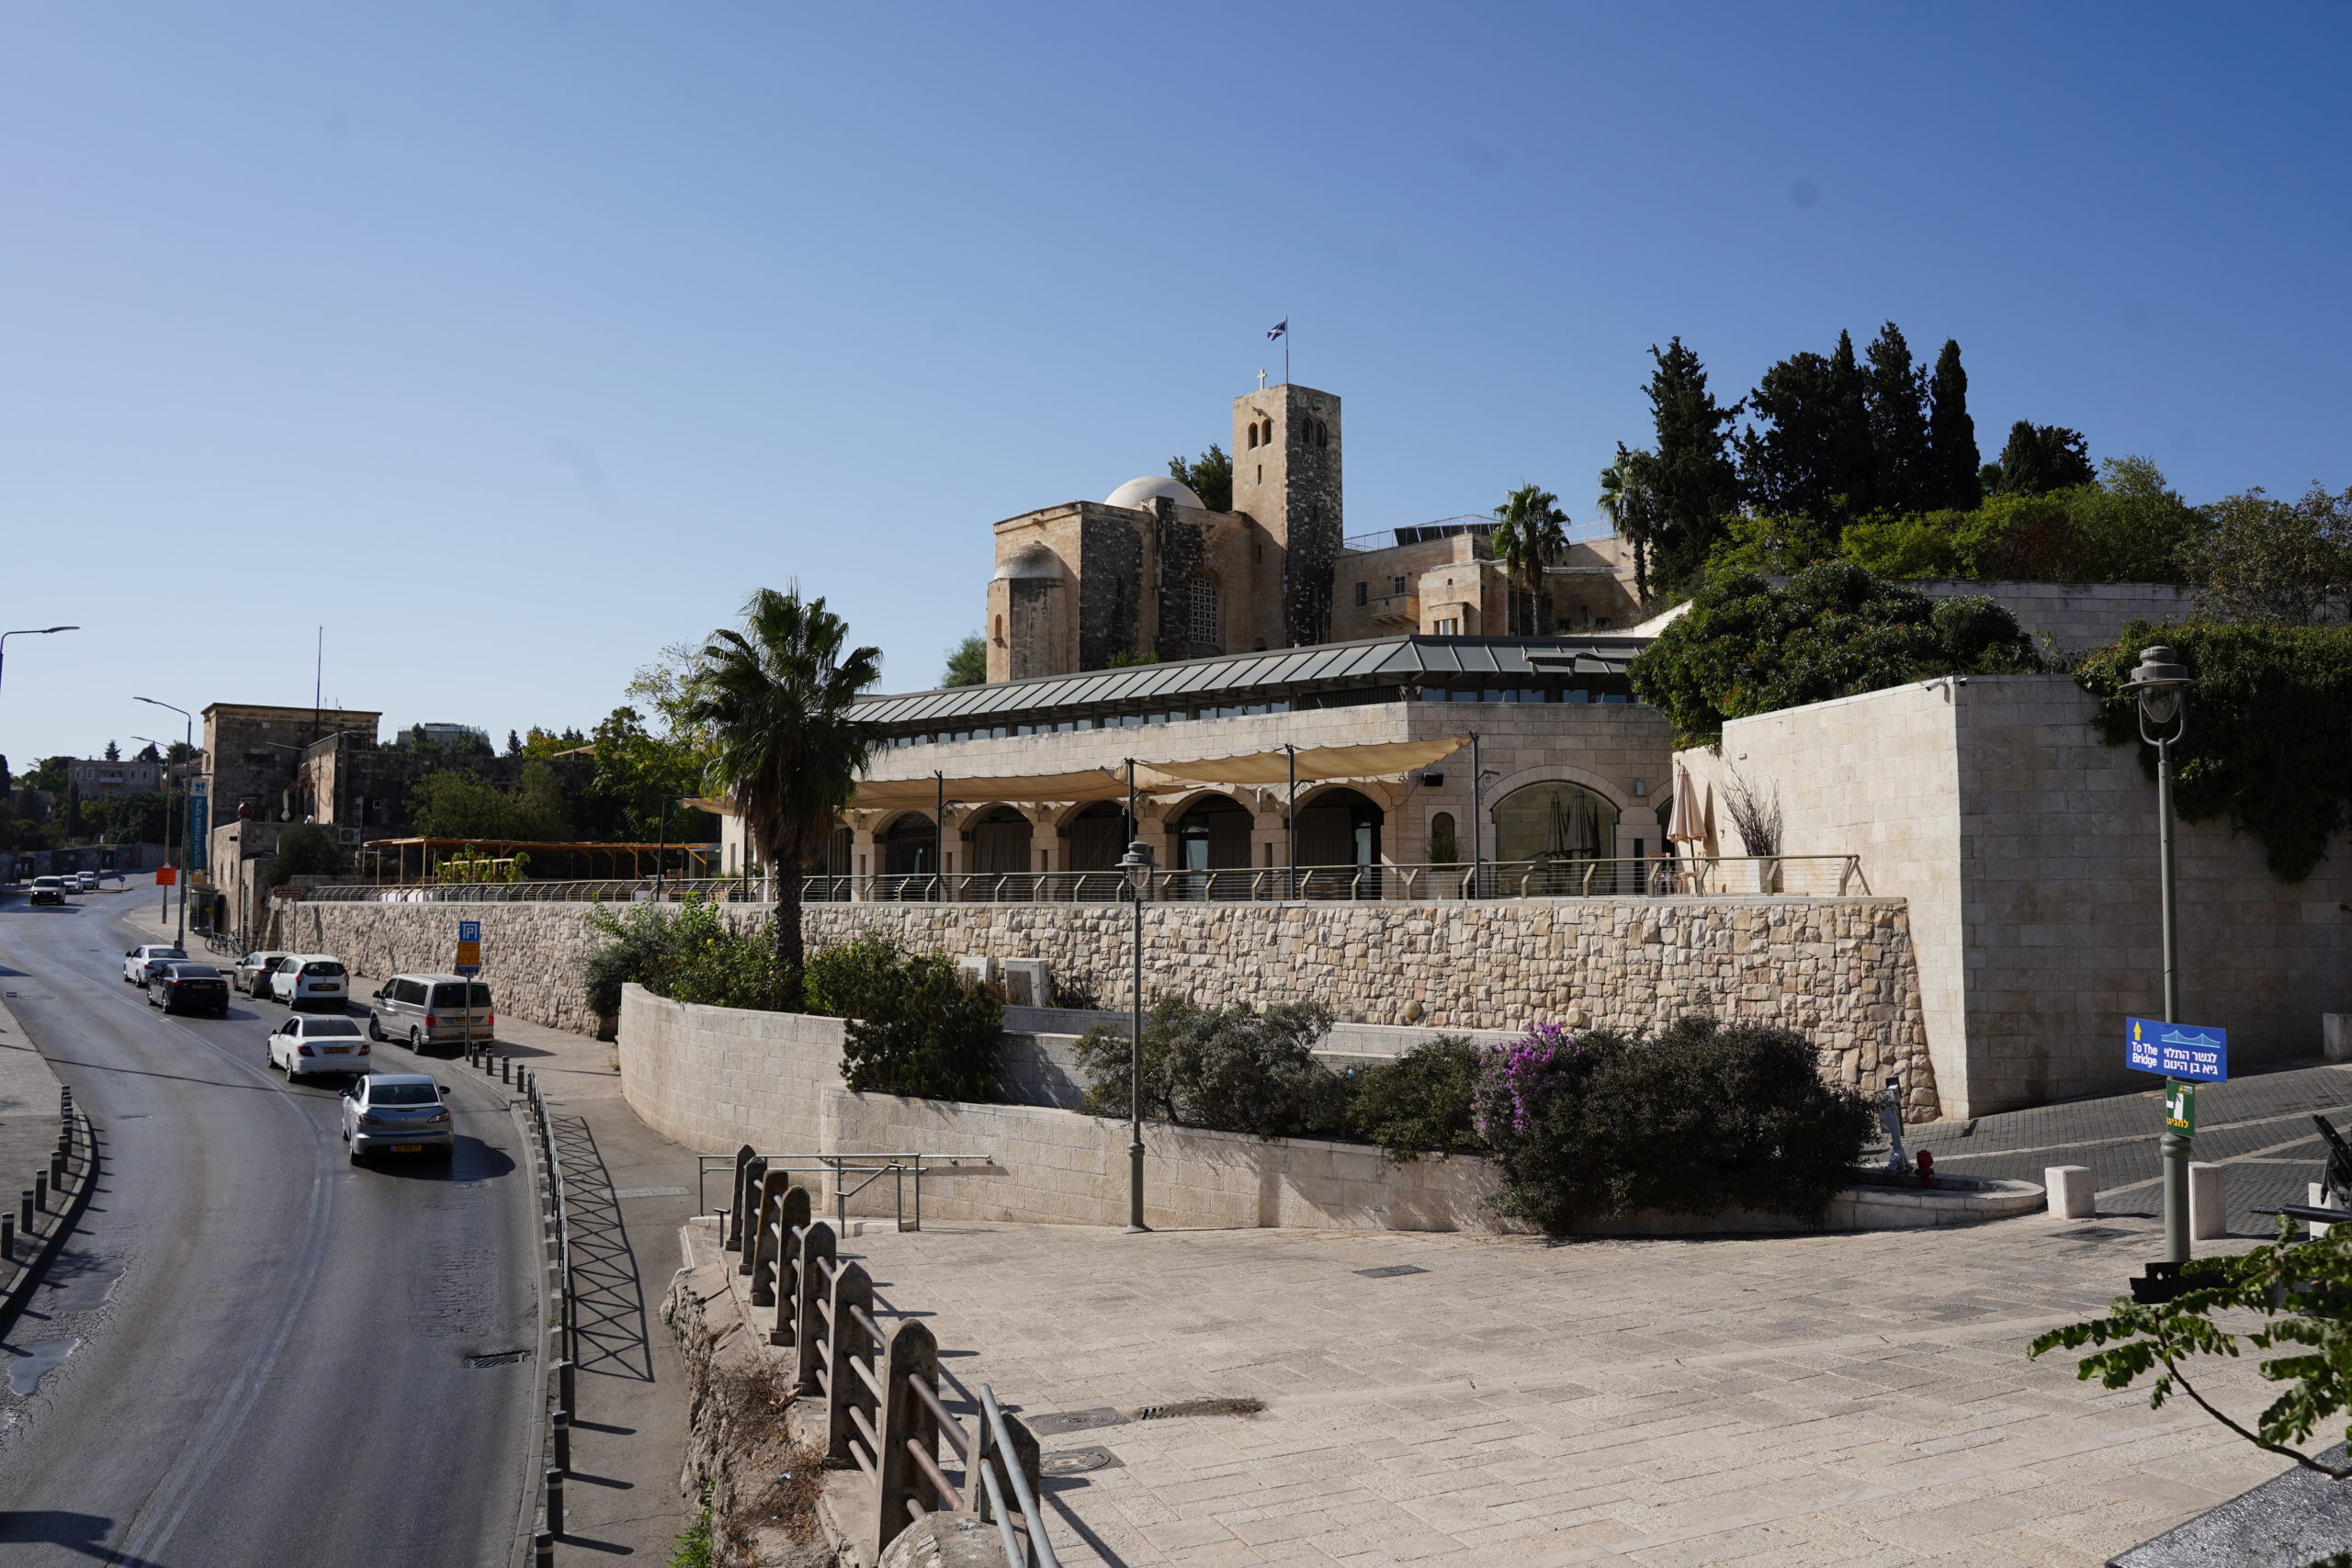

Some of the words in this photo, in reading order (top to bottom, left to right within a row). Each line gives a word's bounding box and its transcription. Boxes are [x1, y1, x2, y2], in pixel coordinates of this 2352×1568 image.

[2132, 1042, 2142, 1053] To
[2143, 1043, 2158, 1055] The
[2164, 1047, 2189, 1060] התלוי
[2132, 1053, 2157, 1068] Bridge
[2191, 1051, 2217, 1064] לגשר
[2163, 1059, 2188, 1071] הינום
[2189, 1062, 2200, 1074] בן
[2201, 1064, 2219, 1076] גיא
